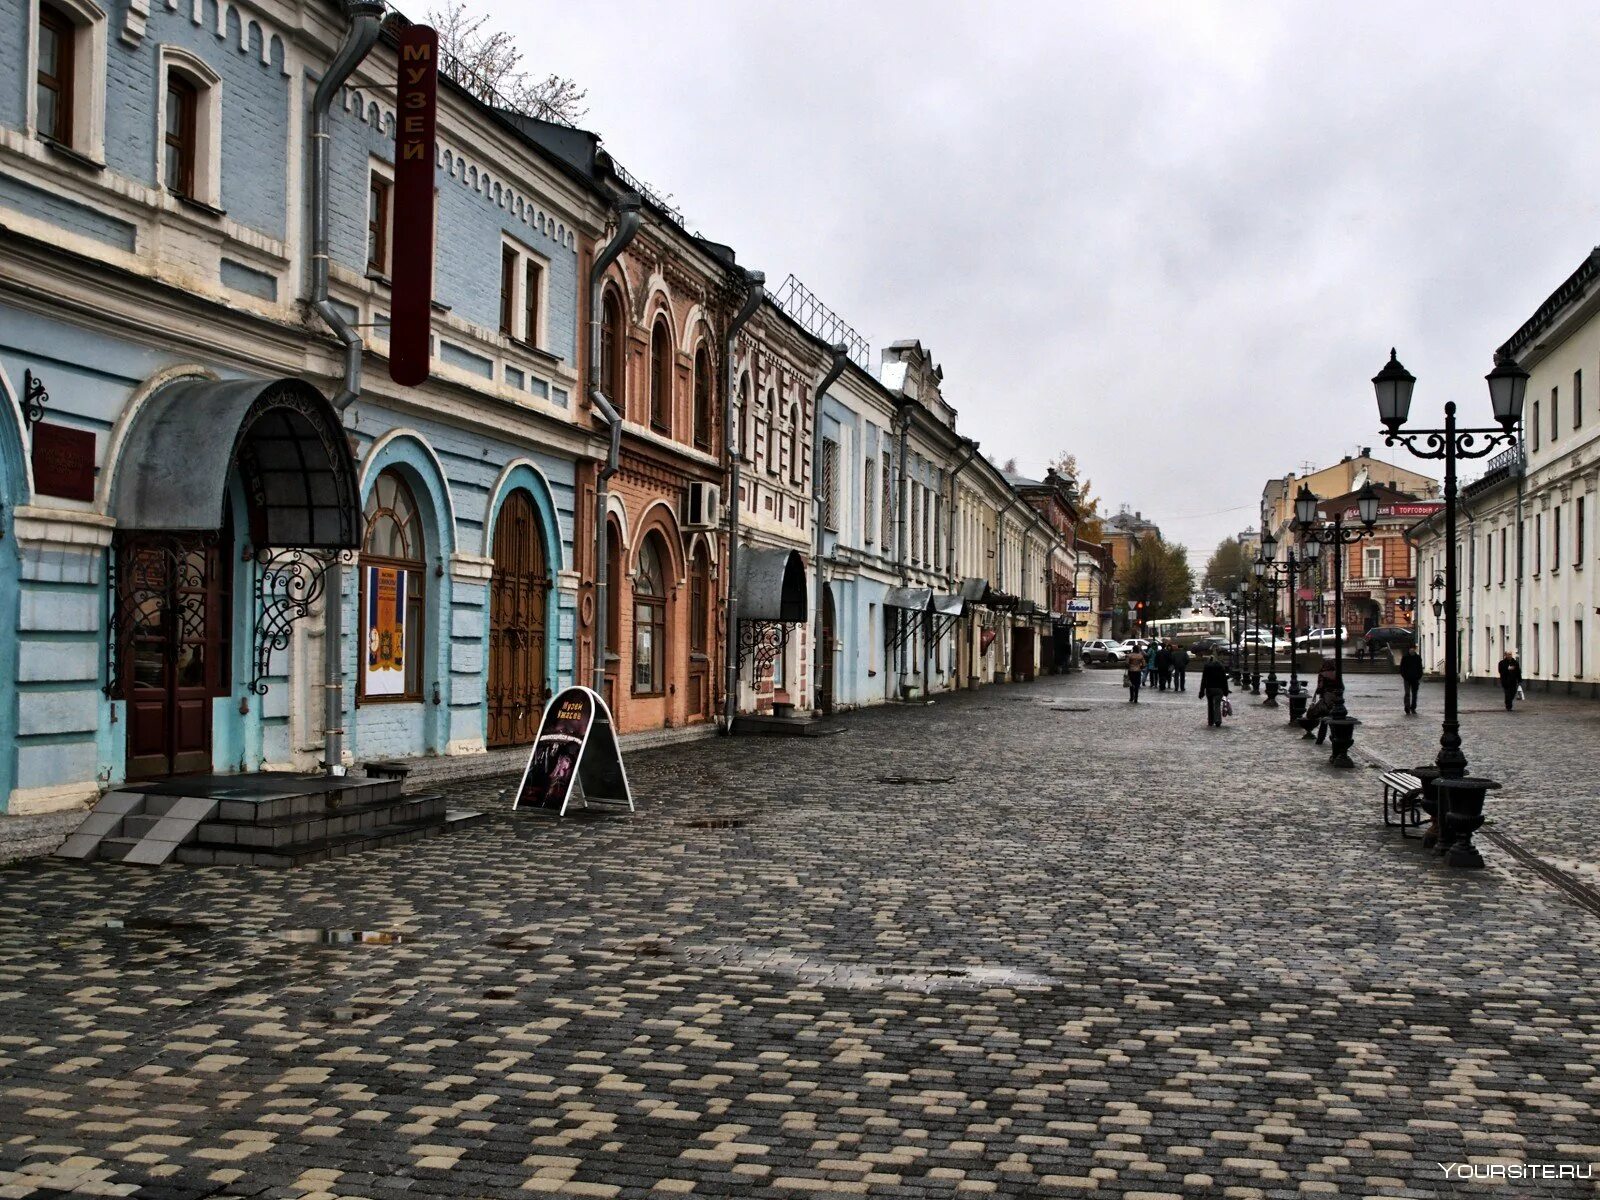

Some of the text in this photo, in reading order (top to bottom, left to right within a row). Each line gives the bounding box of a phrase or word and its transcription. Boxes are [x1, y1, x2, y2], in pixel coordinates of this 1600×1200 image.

[403, 43, 431, 160] МУЗЕЙ
[1399, 506, 1433, 514] ТОРГОВЫЙ
[562, 701, 583, 711] Музей
